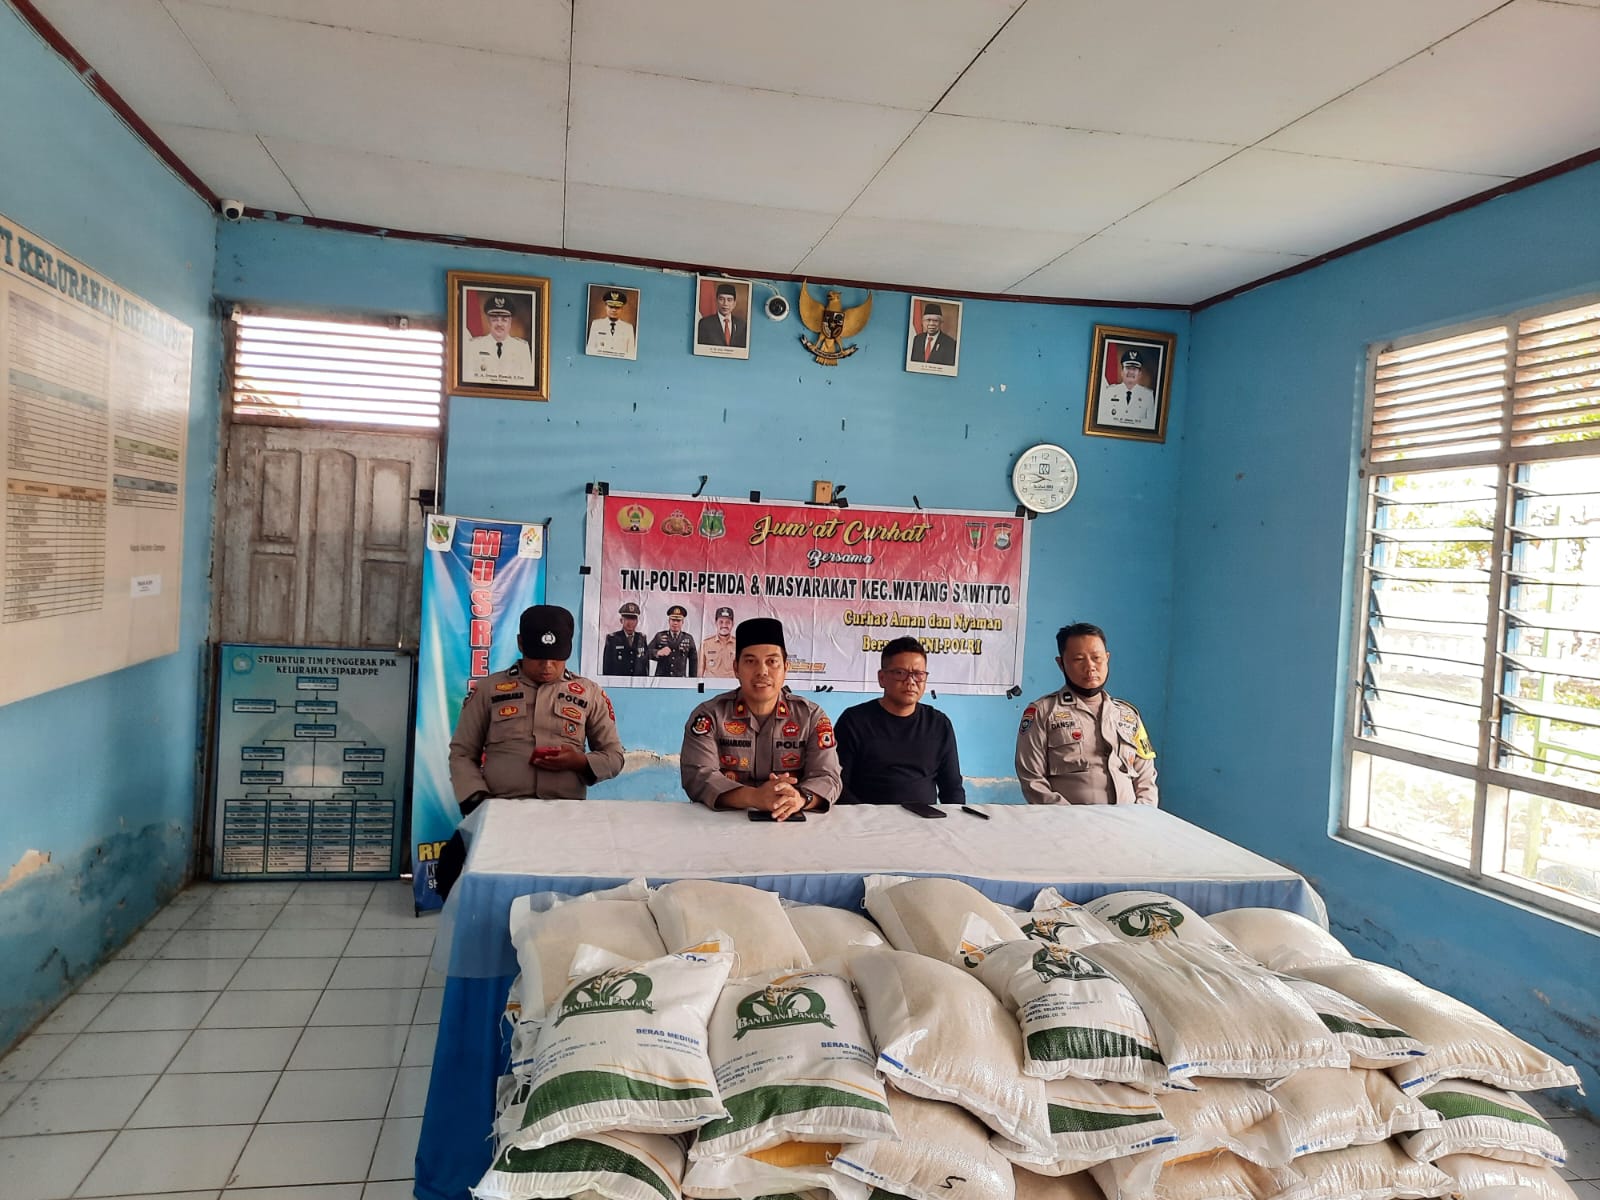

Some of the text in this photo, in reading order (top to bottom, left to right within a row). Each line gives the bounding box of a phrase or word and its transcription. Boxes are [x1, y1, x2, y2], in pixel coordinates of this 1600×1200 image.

[749, 515, 932, 546] Jum'at Curhat
[807, 549, 874, 567] Bersama
[620, 569, 1011, 605] TNI-POLRI-PEMDA & MASYARAKAT KEC.WATANG SAWITTO
[469, 529, 502, 688] MUSRE
[843, 610, 1003, 632] Curhat Aman dan Nyaman
[862, 636, 888, 652] Bers
[257, 655, 397, 667] STRUKTUR TIM PENGGERAK PKK
[276, 665, 379, 676] KELURAHAN SIPARAPPE
[557, 692, 588, 709] POLRI
[557, 995, 653, 1018] BANTUAN PANGAN
[736, 1008, 832, 1030] BANTUAN PANGAN
[636, 1028, 700, 1046] BERAS MEDIUM
[820, 1041, 850, 1049] BERAS
